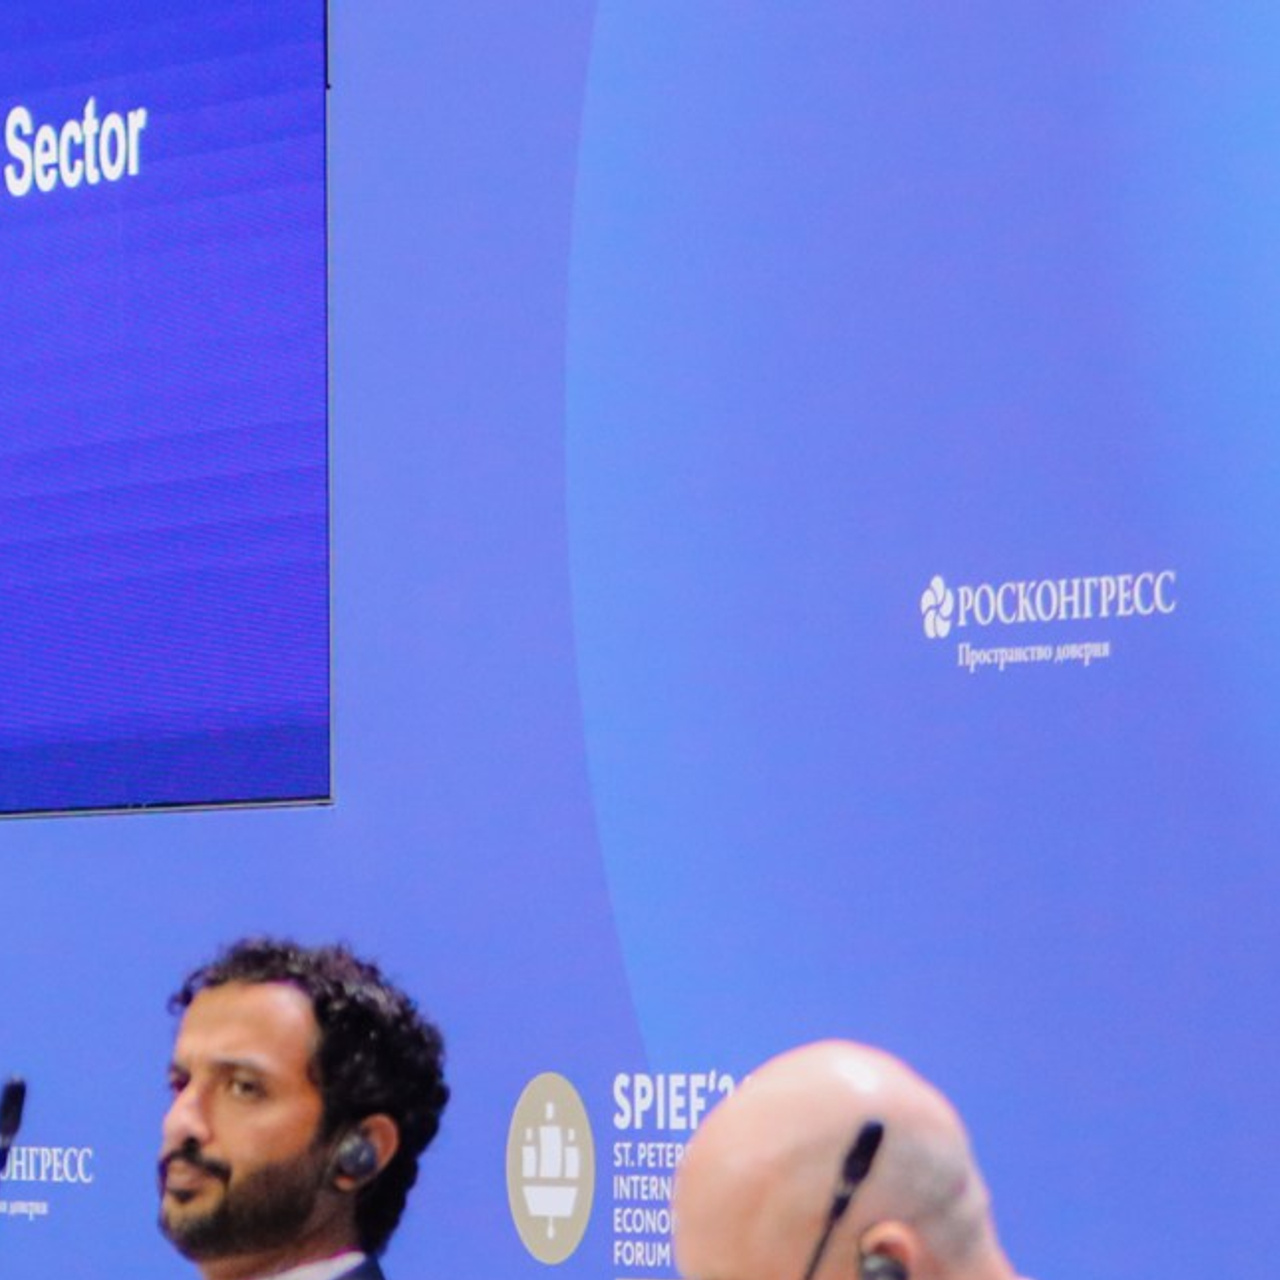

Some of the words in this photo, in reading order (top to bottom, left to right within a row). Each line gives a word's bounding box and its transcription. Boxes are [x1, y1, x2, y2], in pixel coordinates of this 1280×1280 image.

[4, 96, 149, 197] Sector
[957, 570, 1177, 627] РОСКОНГРЕСС
[957, 642, 1053, 673] Пространство
[613, 1142, 635, 1168] ST.
[613, 1240, 671, 1267] FORUM
